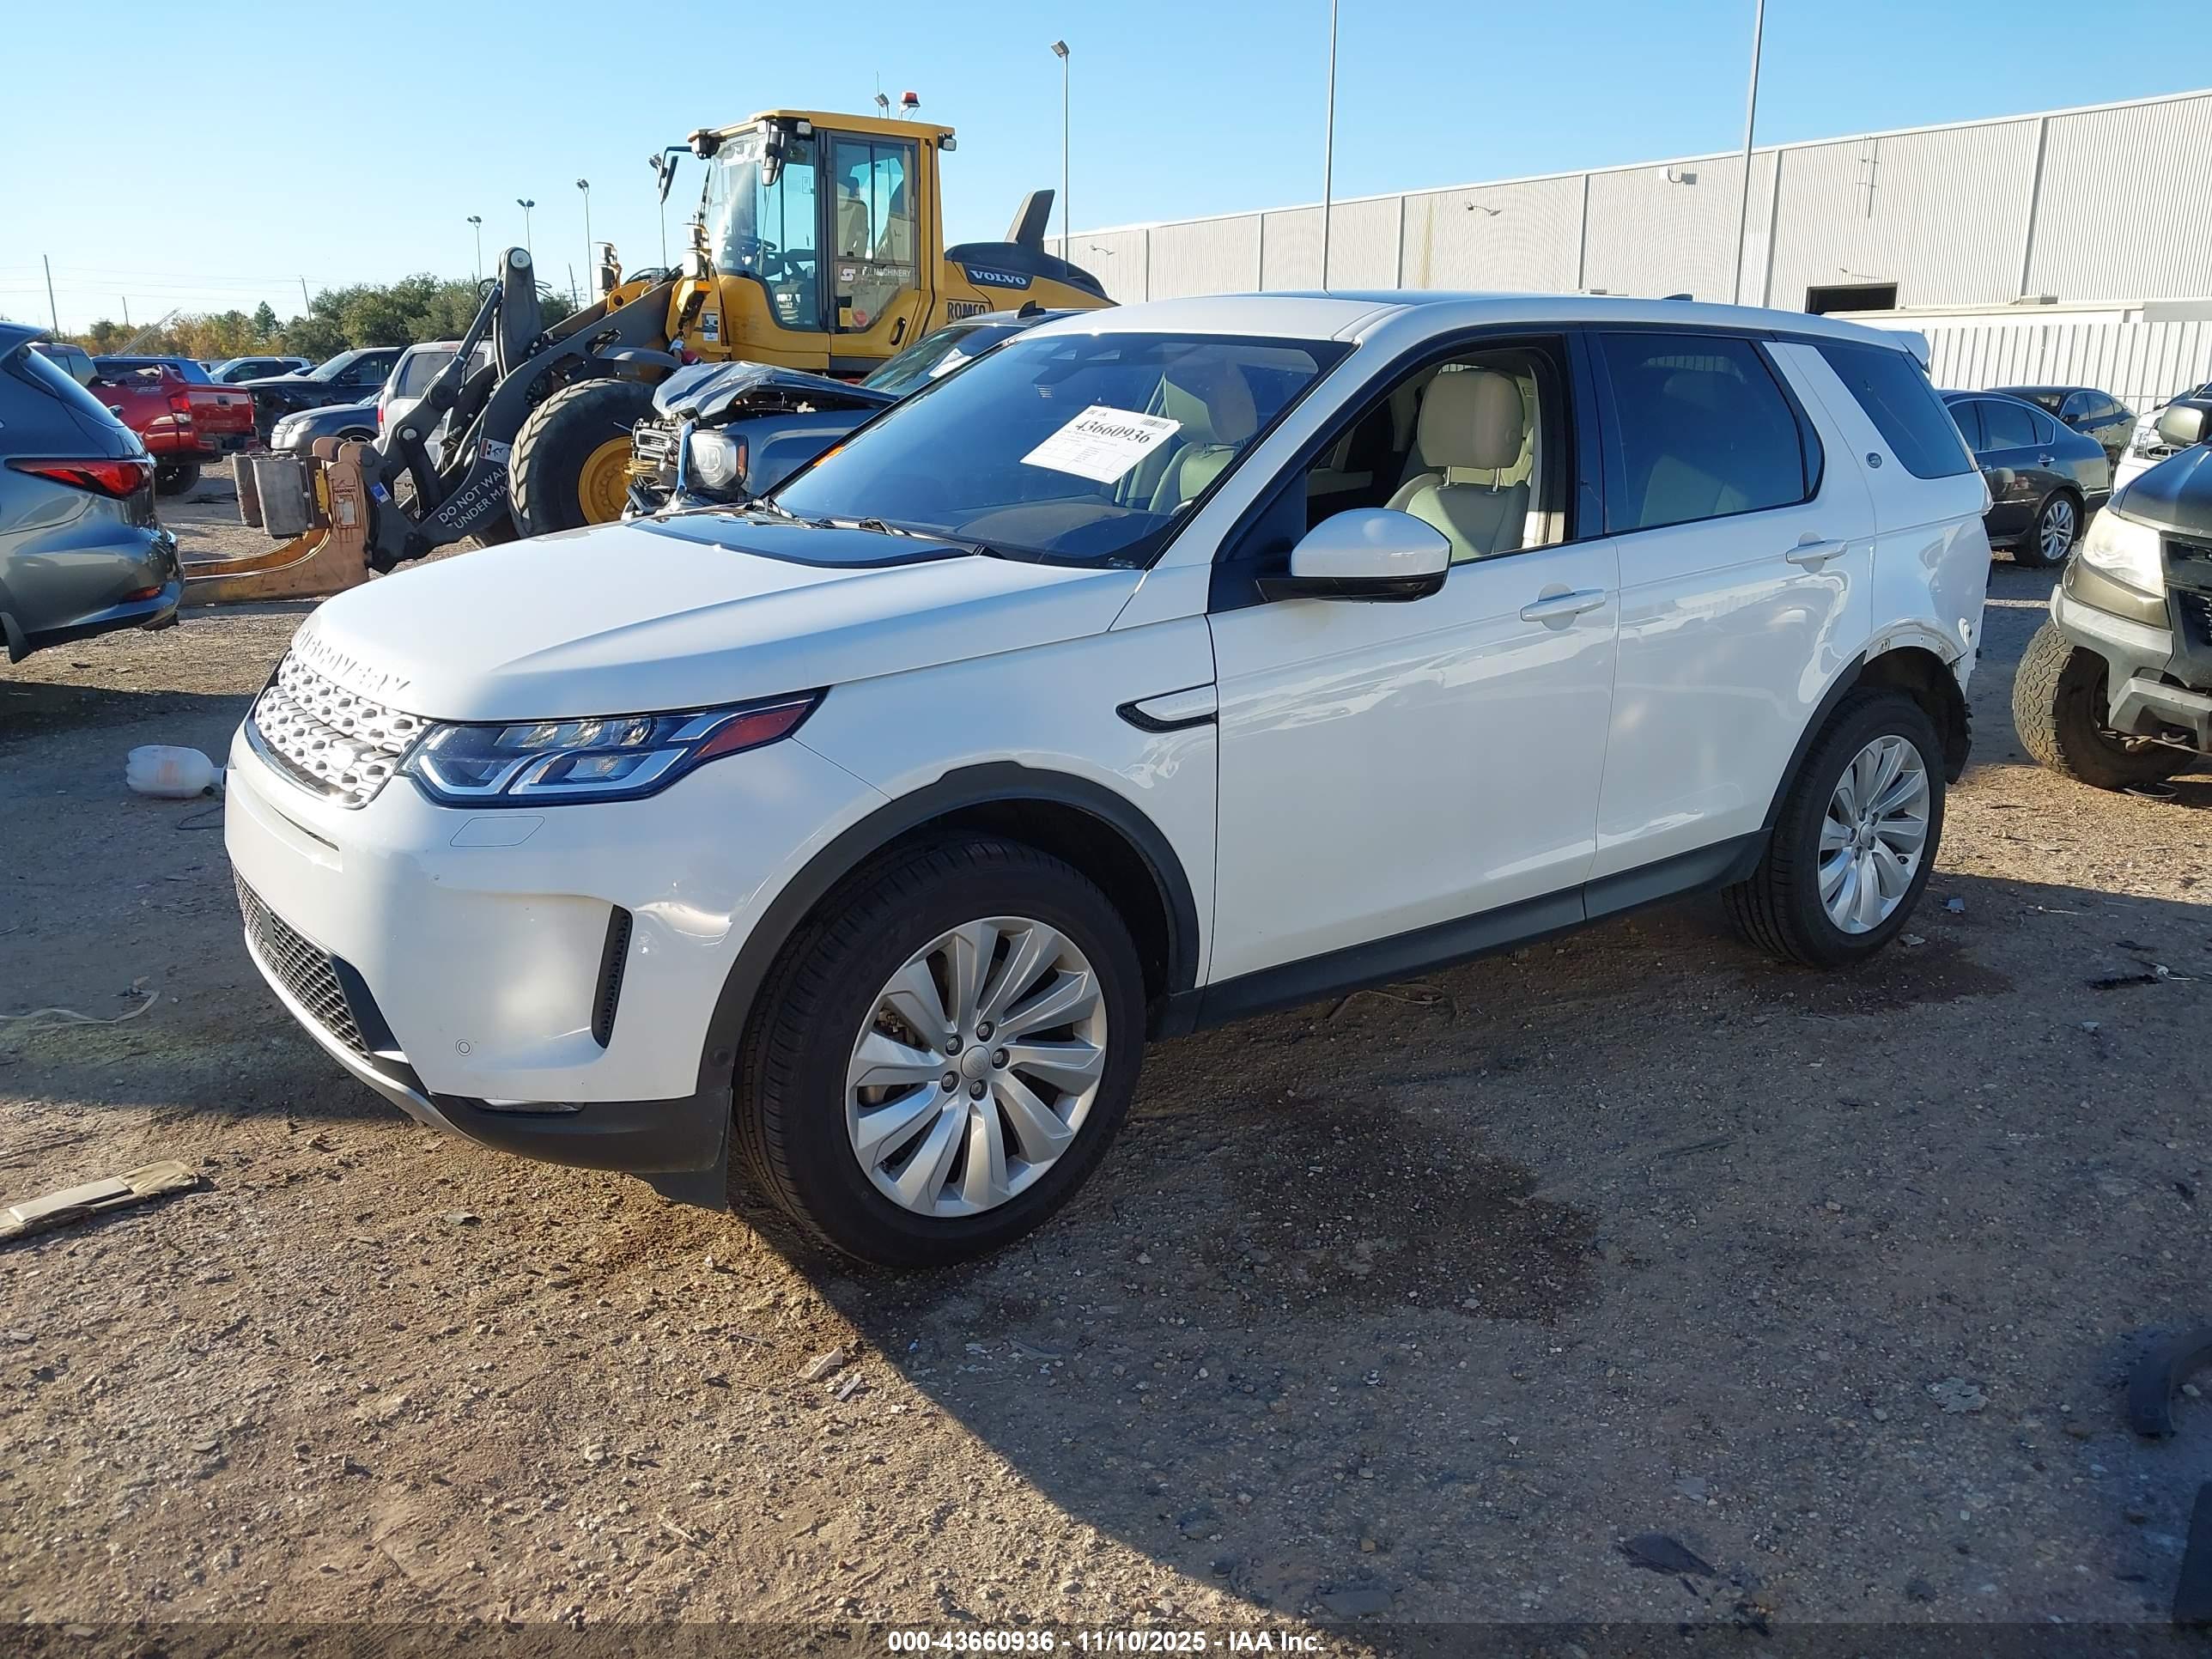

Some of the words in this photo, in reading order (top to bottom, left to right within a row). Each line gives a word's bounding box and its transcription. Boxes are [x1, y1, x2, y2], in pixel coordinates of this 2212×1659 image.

[969, 270, 1027, 285] VOLVO
[1074, 419, 1156, 444] 43660936
[438, 506, 457, 523] DO
[456, 484, 481, 508] NOT
[453, 498, 491, 529] UNDER
